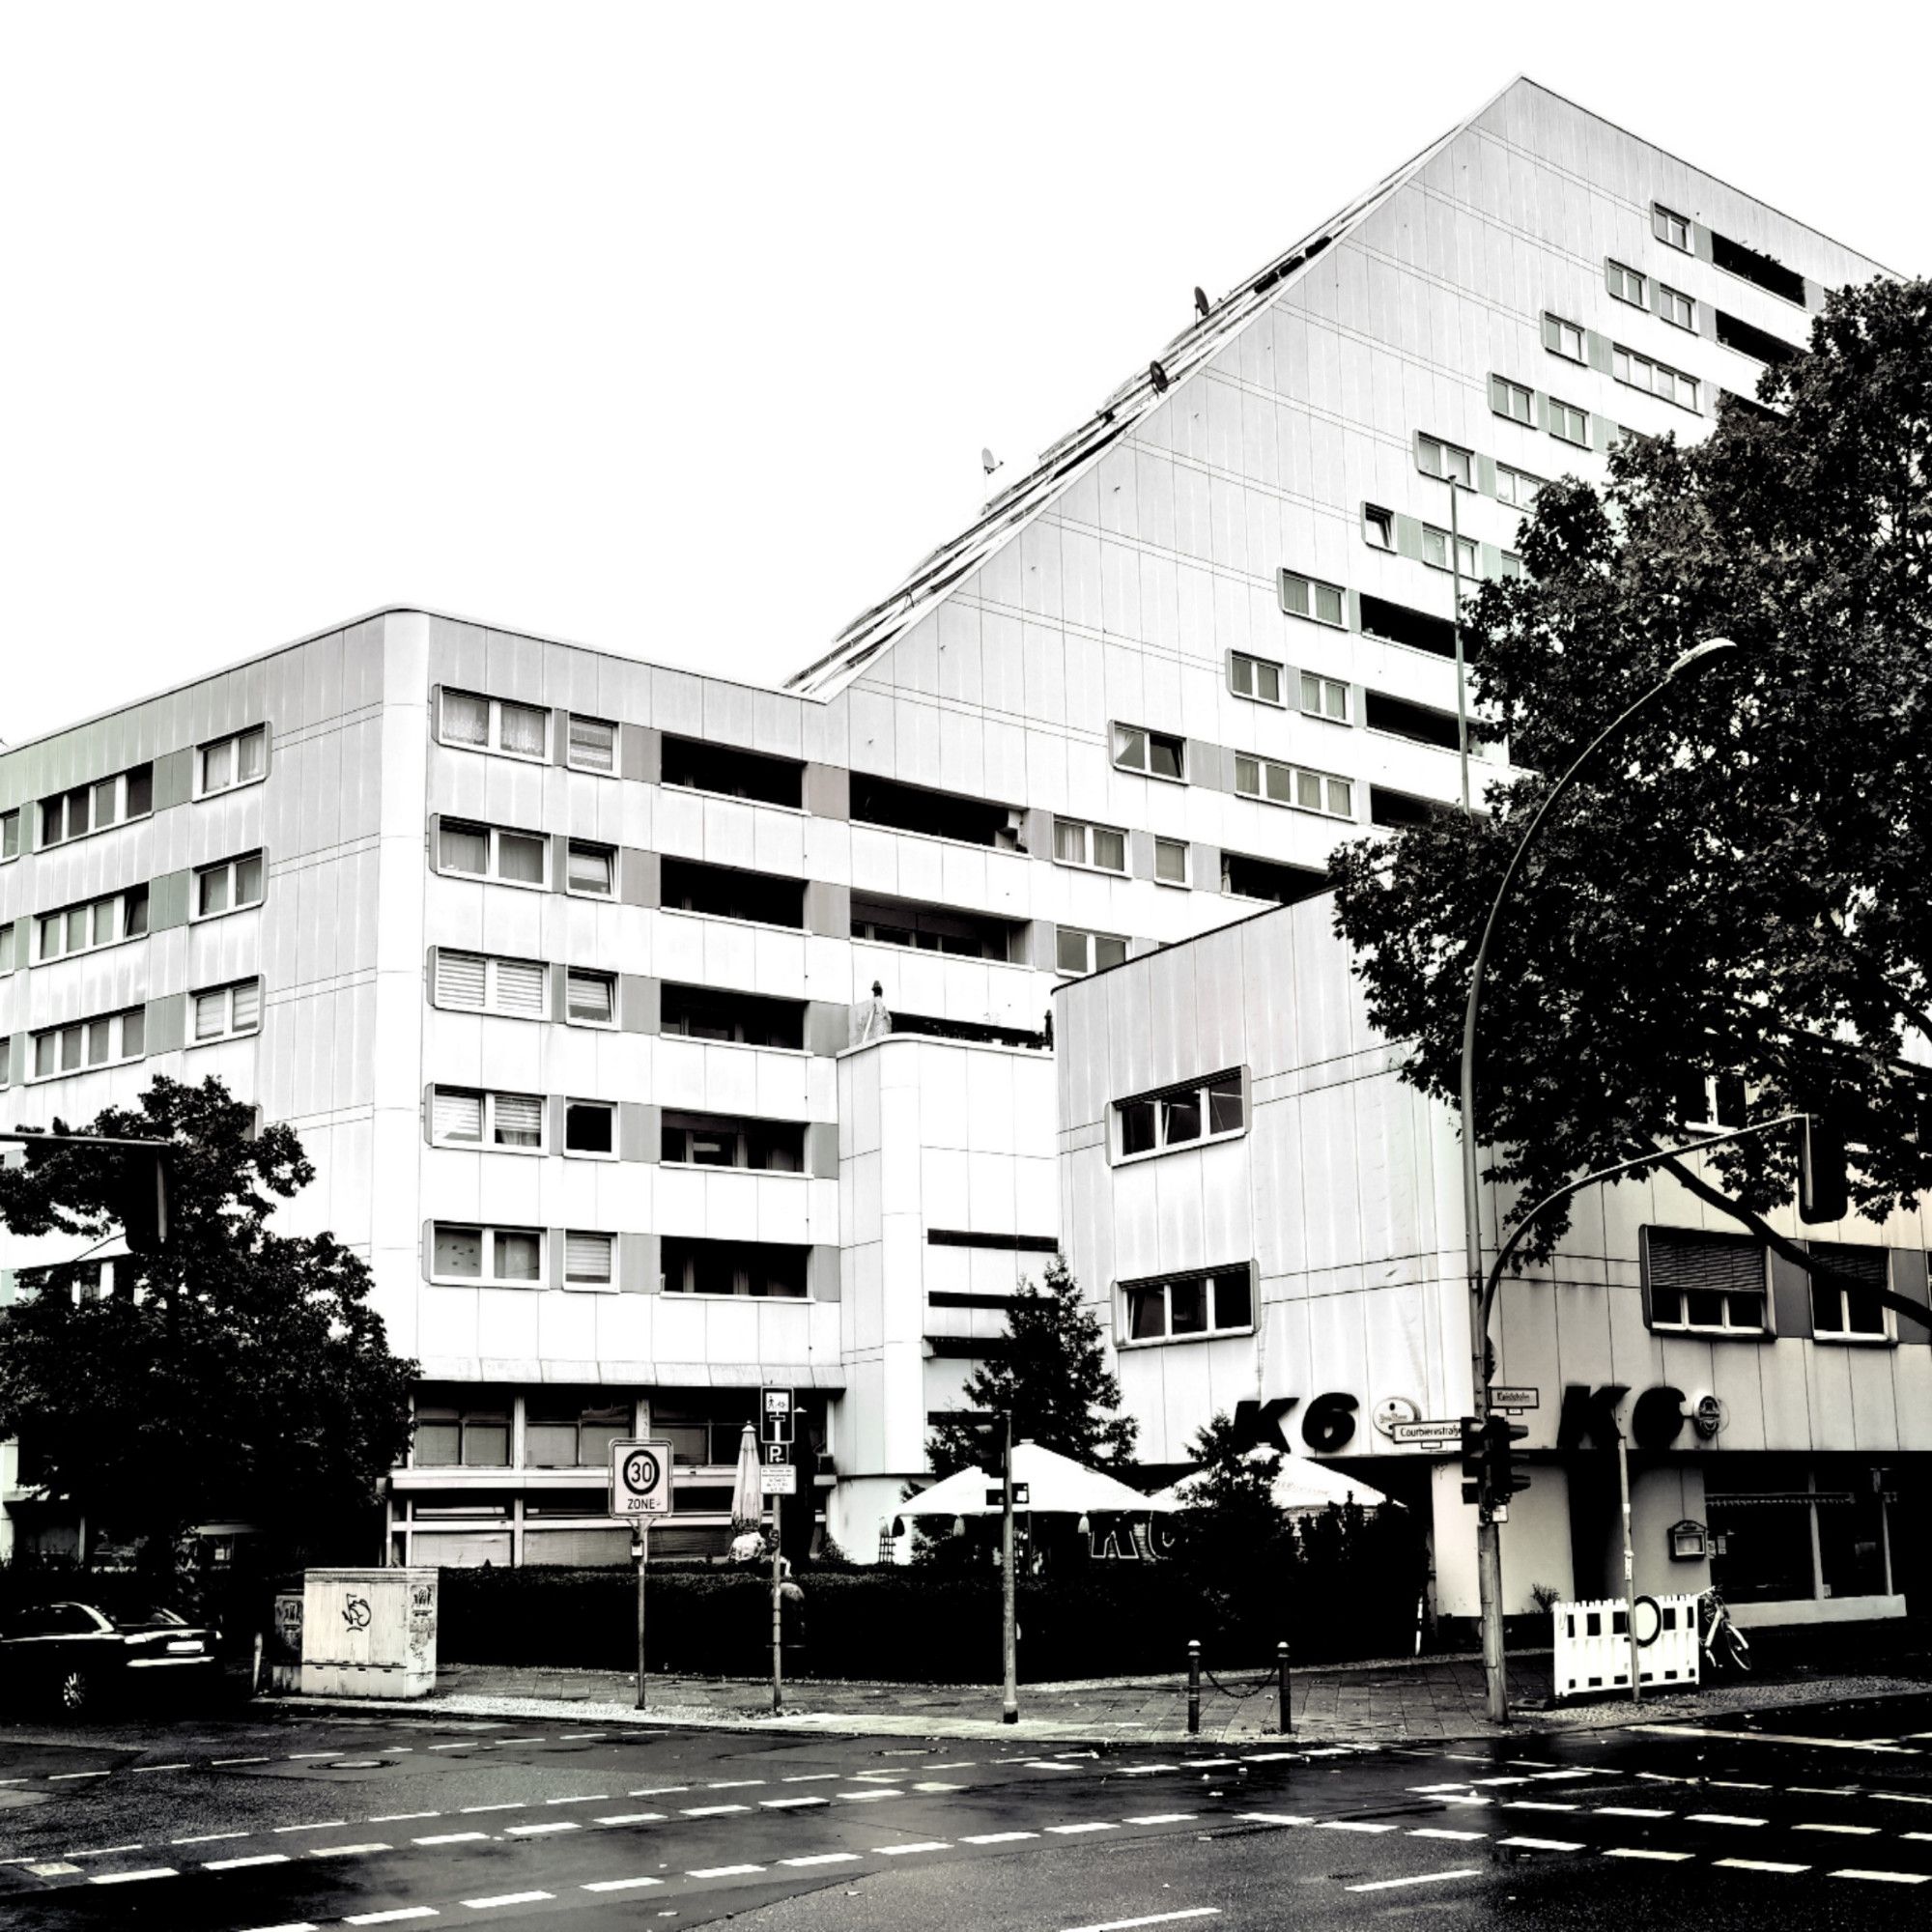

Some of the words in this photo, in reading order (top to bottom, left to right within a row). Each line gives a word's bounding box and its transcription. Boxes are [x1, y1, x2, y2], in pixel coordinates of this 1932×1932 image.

[1233, 1392, 1360, 1455] K6
[769, 1445, 782, 1463] P
[631, 1461, 653, 1484] 30
[627, 1498, 656, 1510] ZONE
